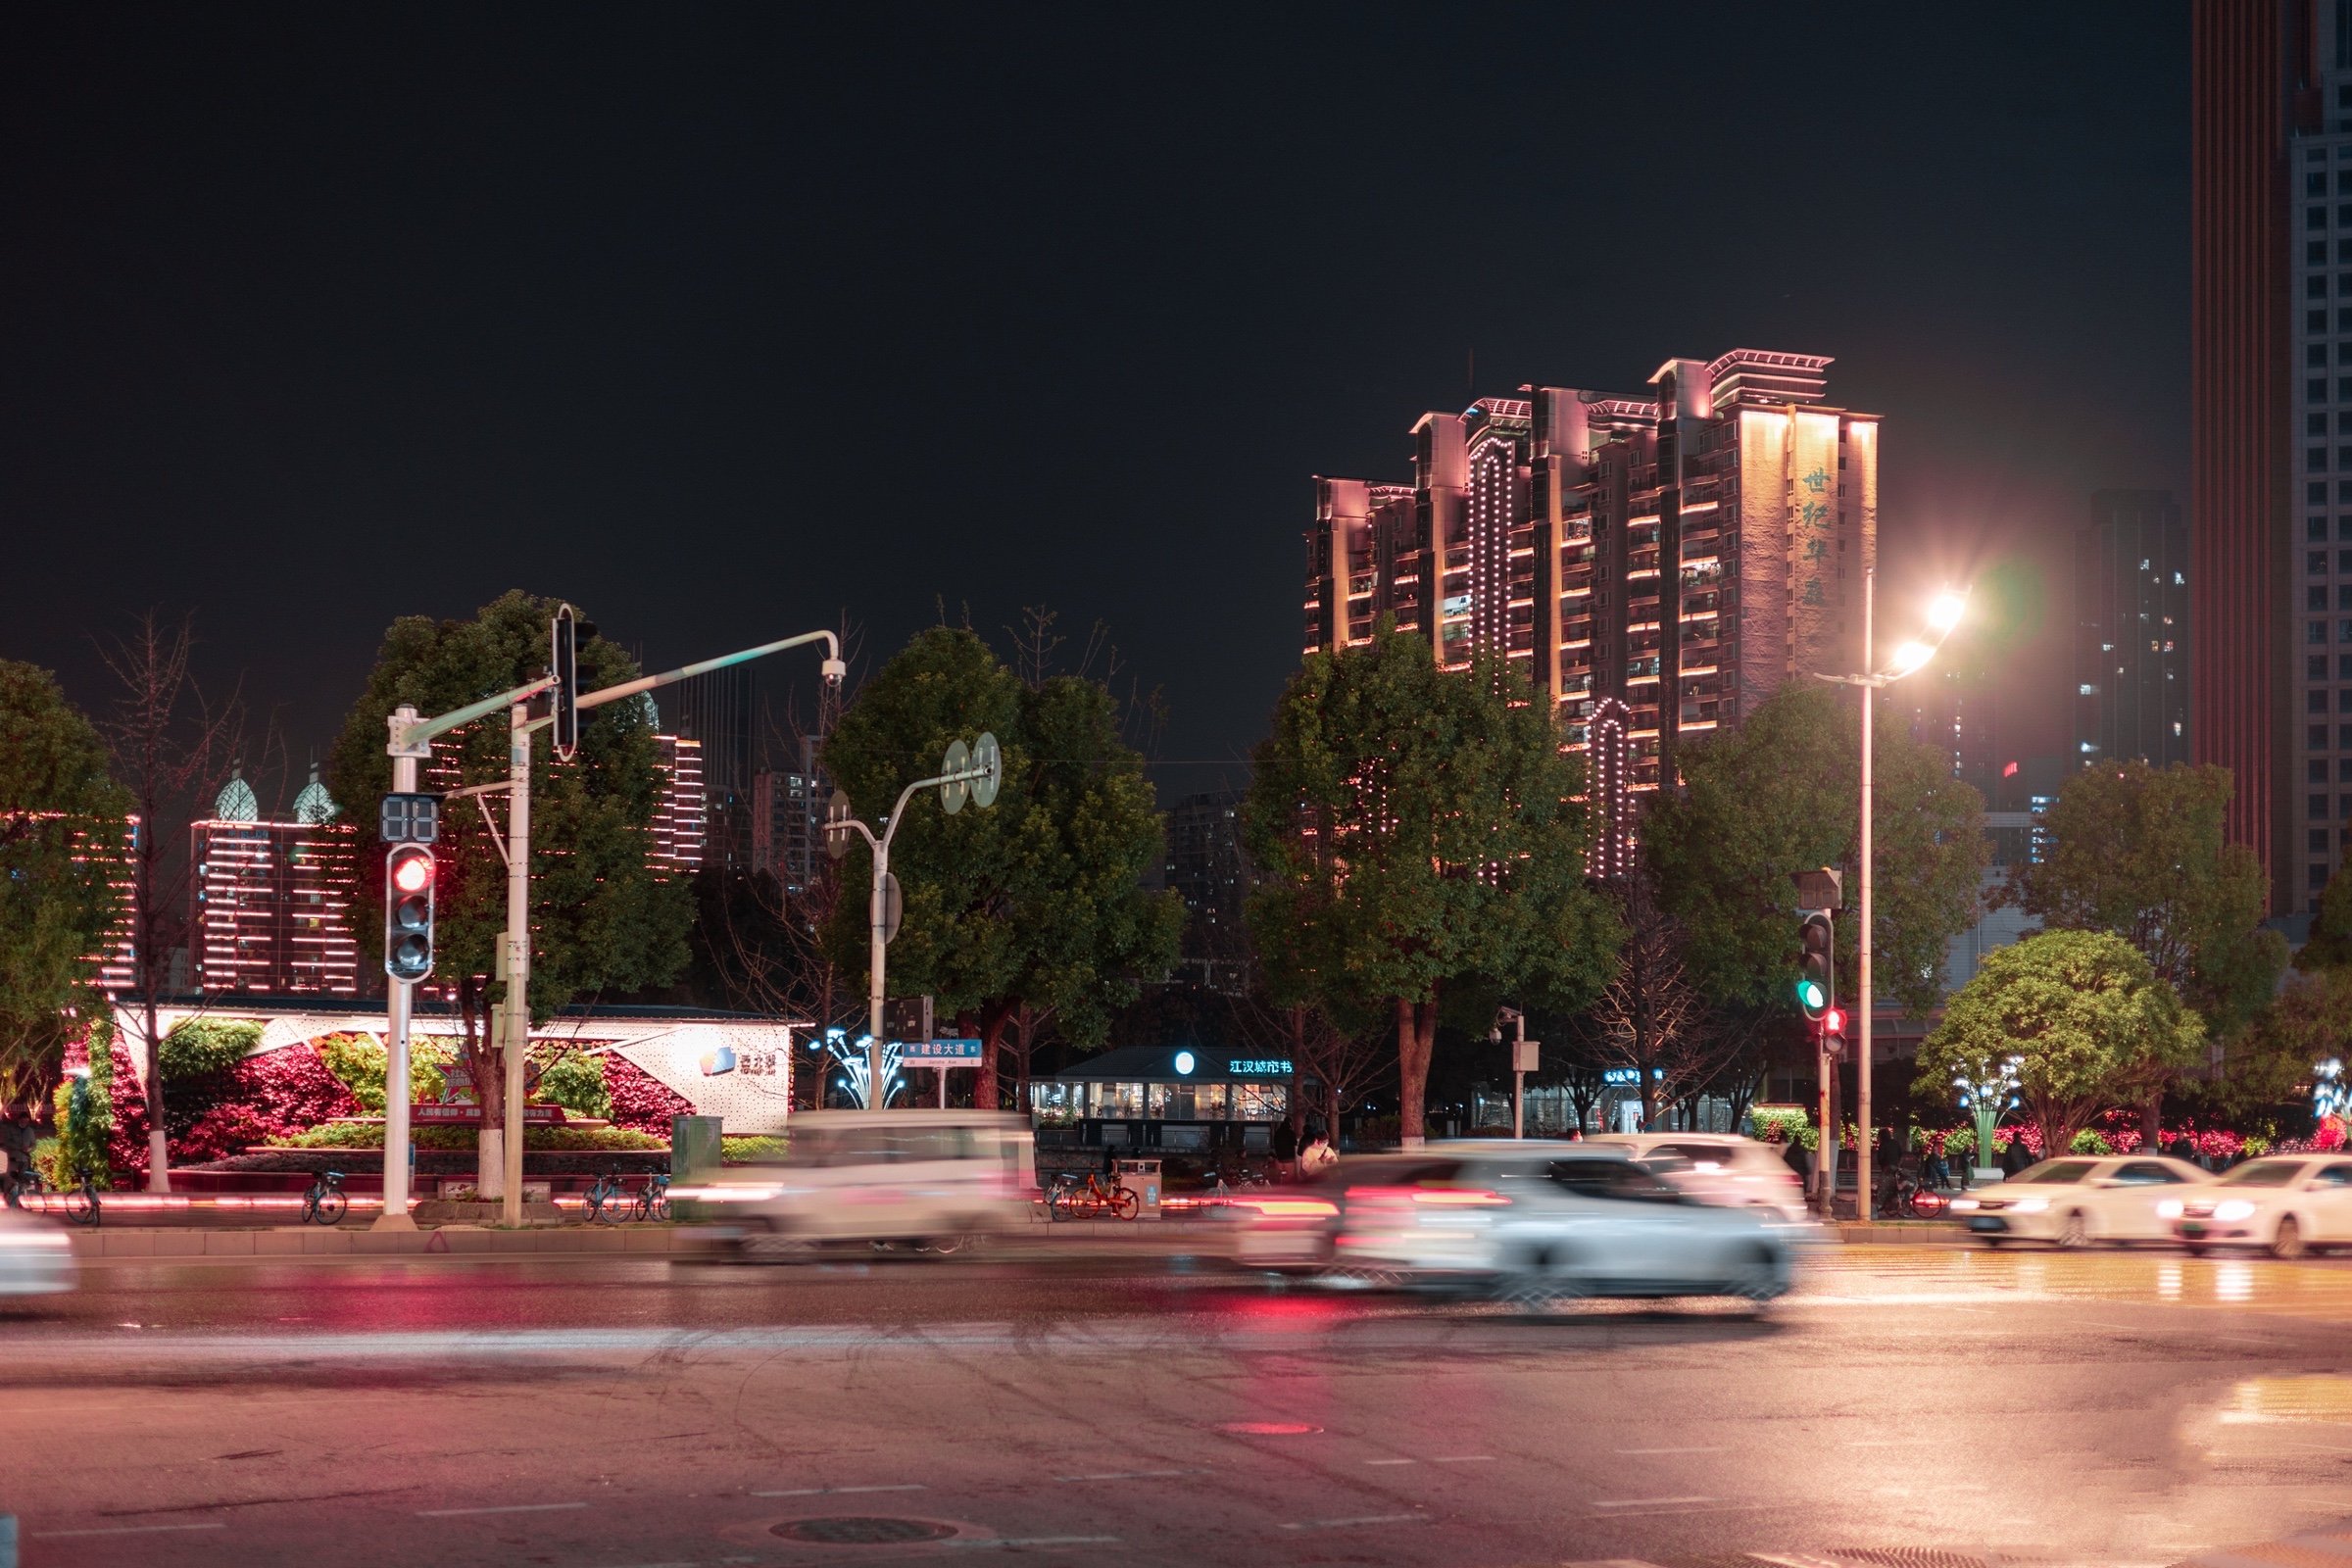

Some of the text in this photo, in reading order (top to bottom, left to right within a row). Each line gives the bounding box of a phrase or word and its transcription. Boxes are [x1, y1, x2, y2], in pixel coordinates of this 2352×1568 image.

[921, 1044, 965, 1055] 建设大道
[1229, 1059, 1294, 1073] 江汉城市书
